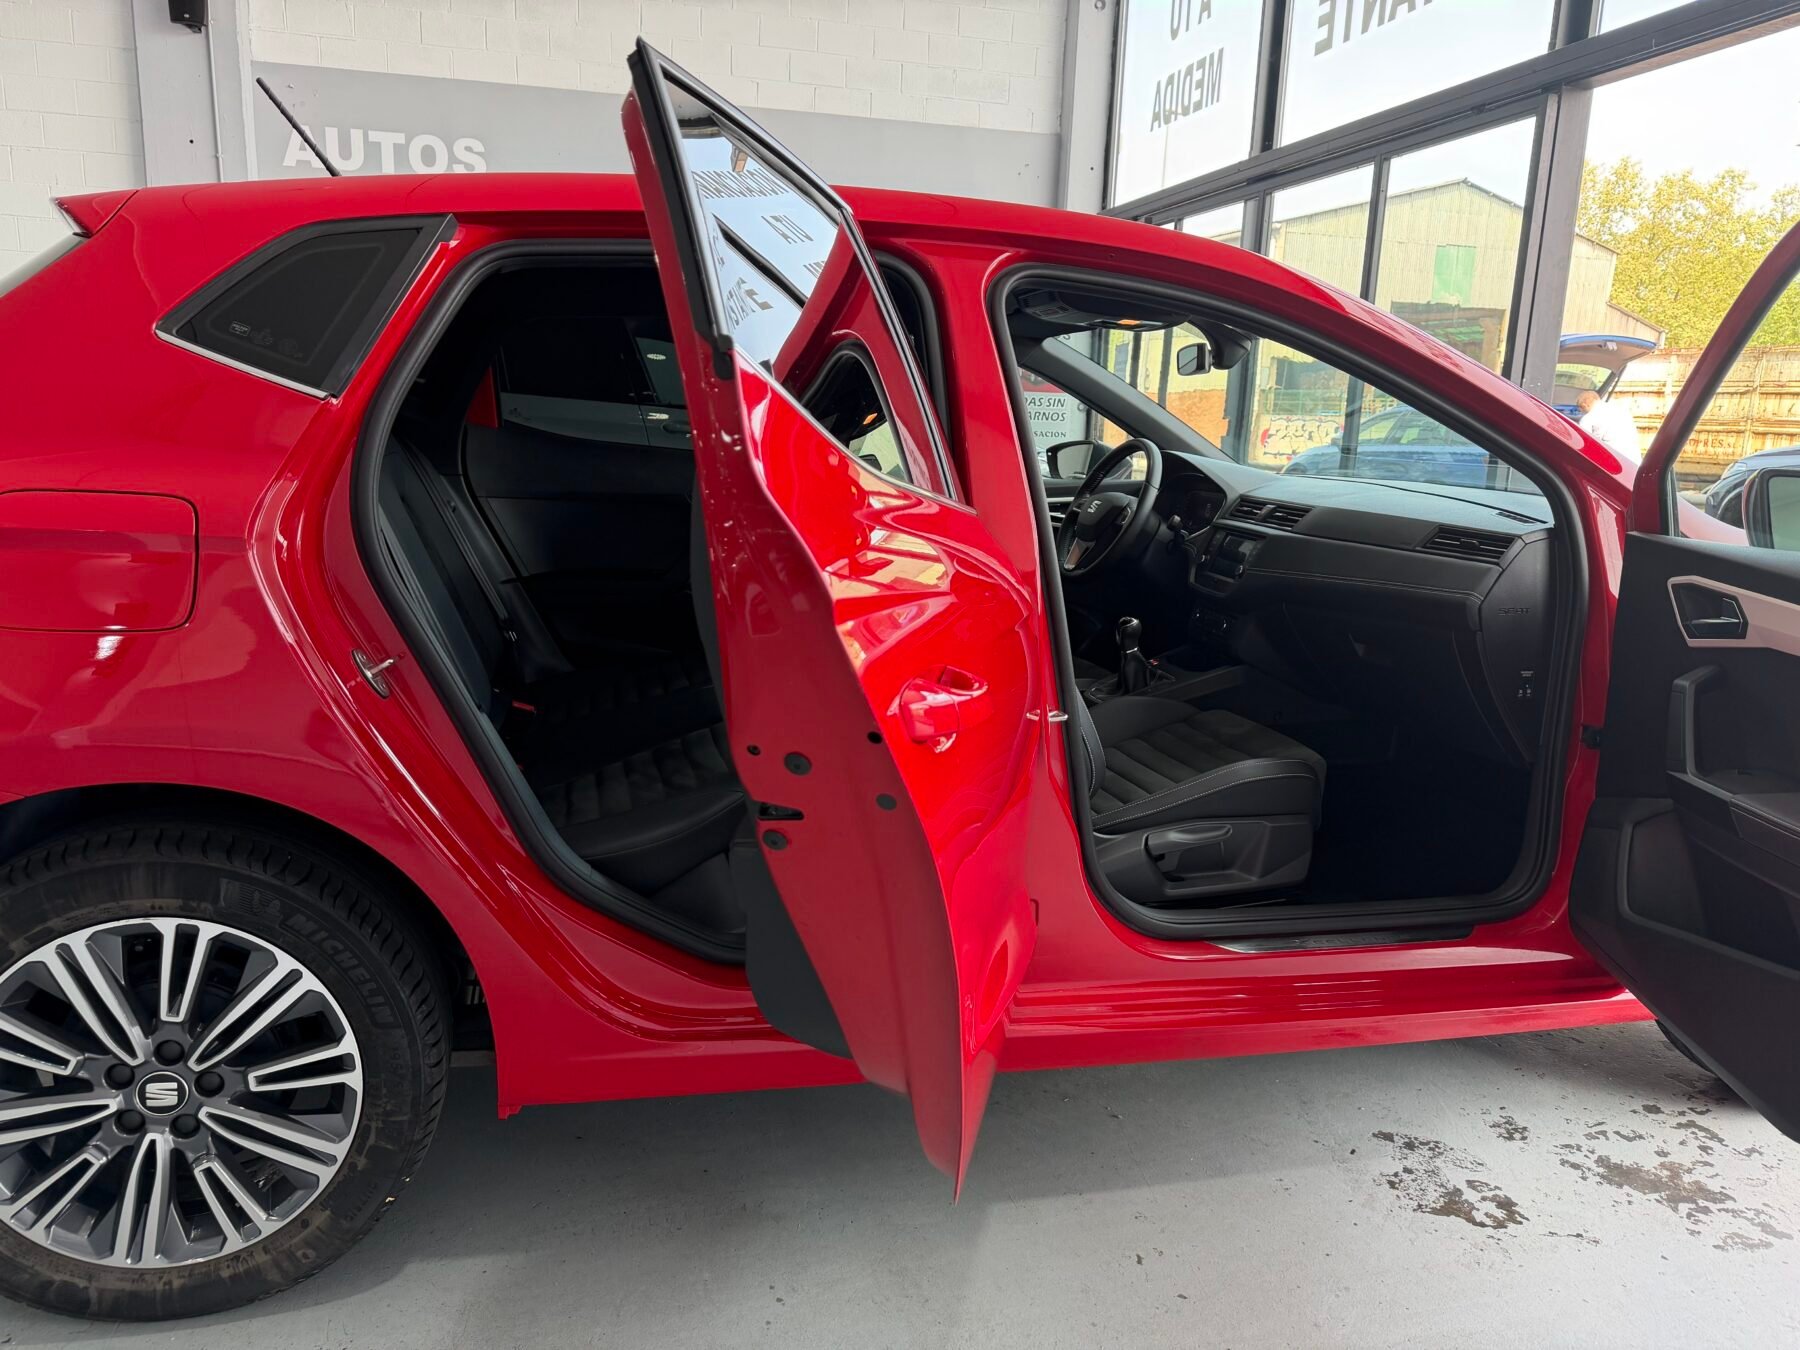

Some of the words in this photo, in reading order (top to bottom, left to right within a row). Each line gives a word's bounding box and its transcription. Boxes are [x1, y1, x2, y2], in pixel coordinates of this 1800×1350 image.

[282, 125, 487, 174] AUTOS
[1045, 397, 1066, 408] SIN
[285, 913, 396, 1029] MICHELIN
